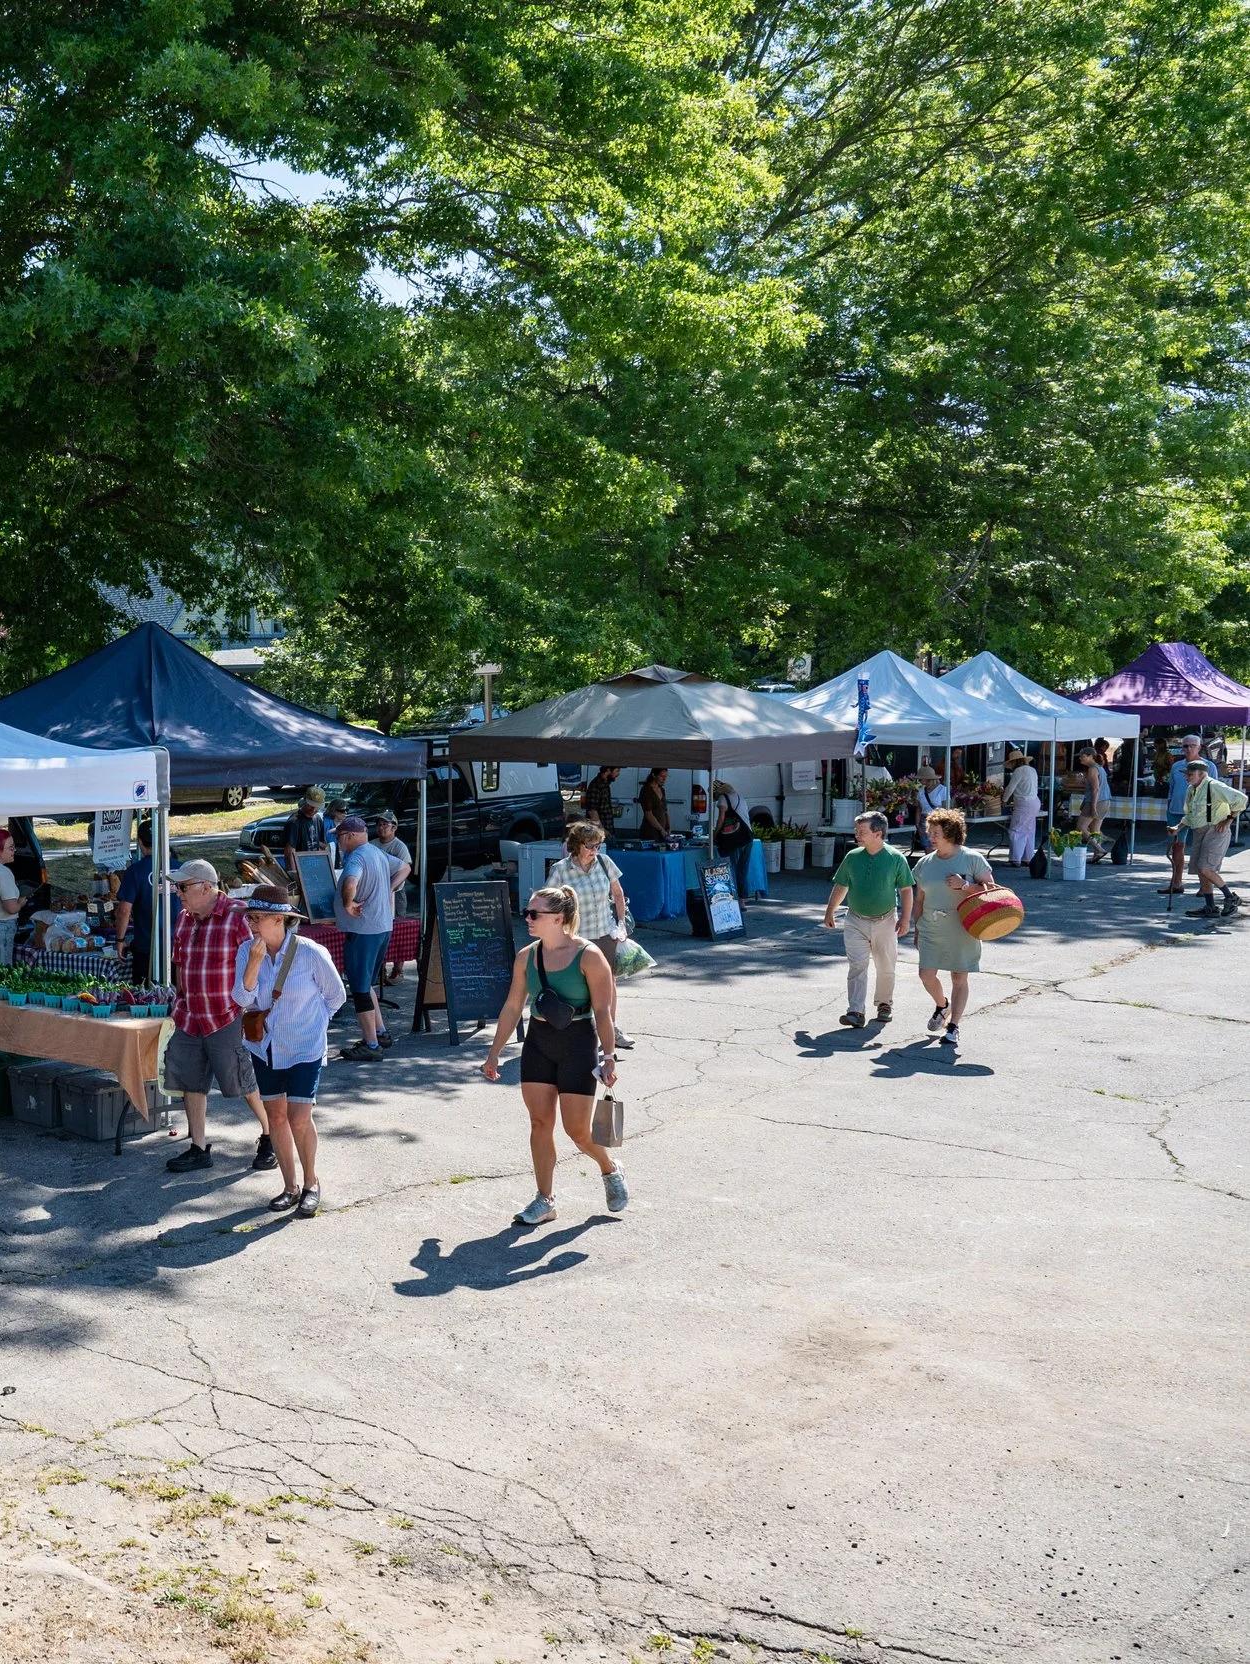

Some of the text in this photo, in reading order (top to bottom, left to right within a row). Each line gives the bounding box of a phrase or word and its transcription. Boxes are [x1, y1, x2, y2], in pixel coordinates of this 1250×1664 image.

[100, 823, 122, 832] BAKING
[704, 866, 728, 877] ALASKA
[705, 873, 730, 885] SEAFOOD
